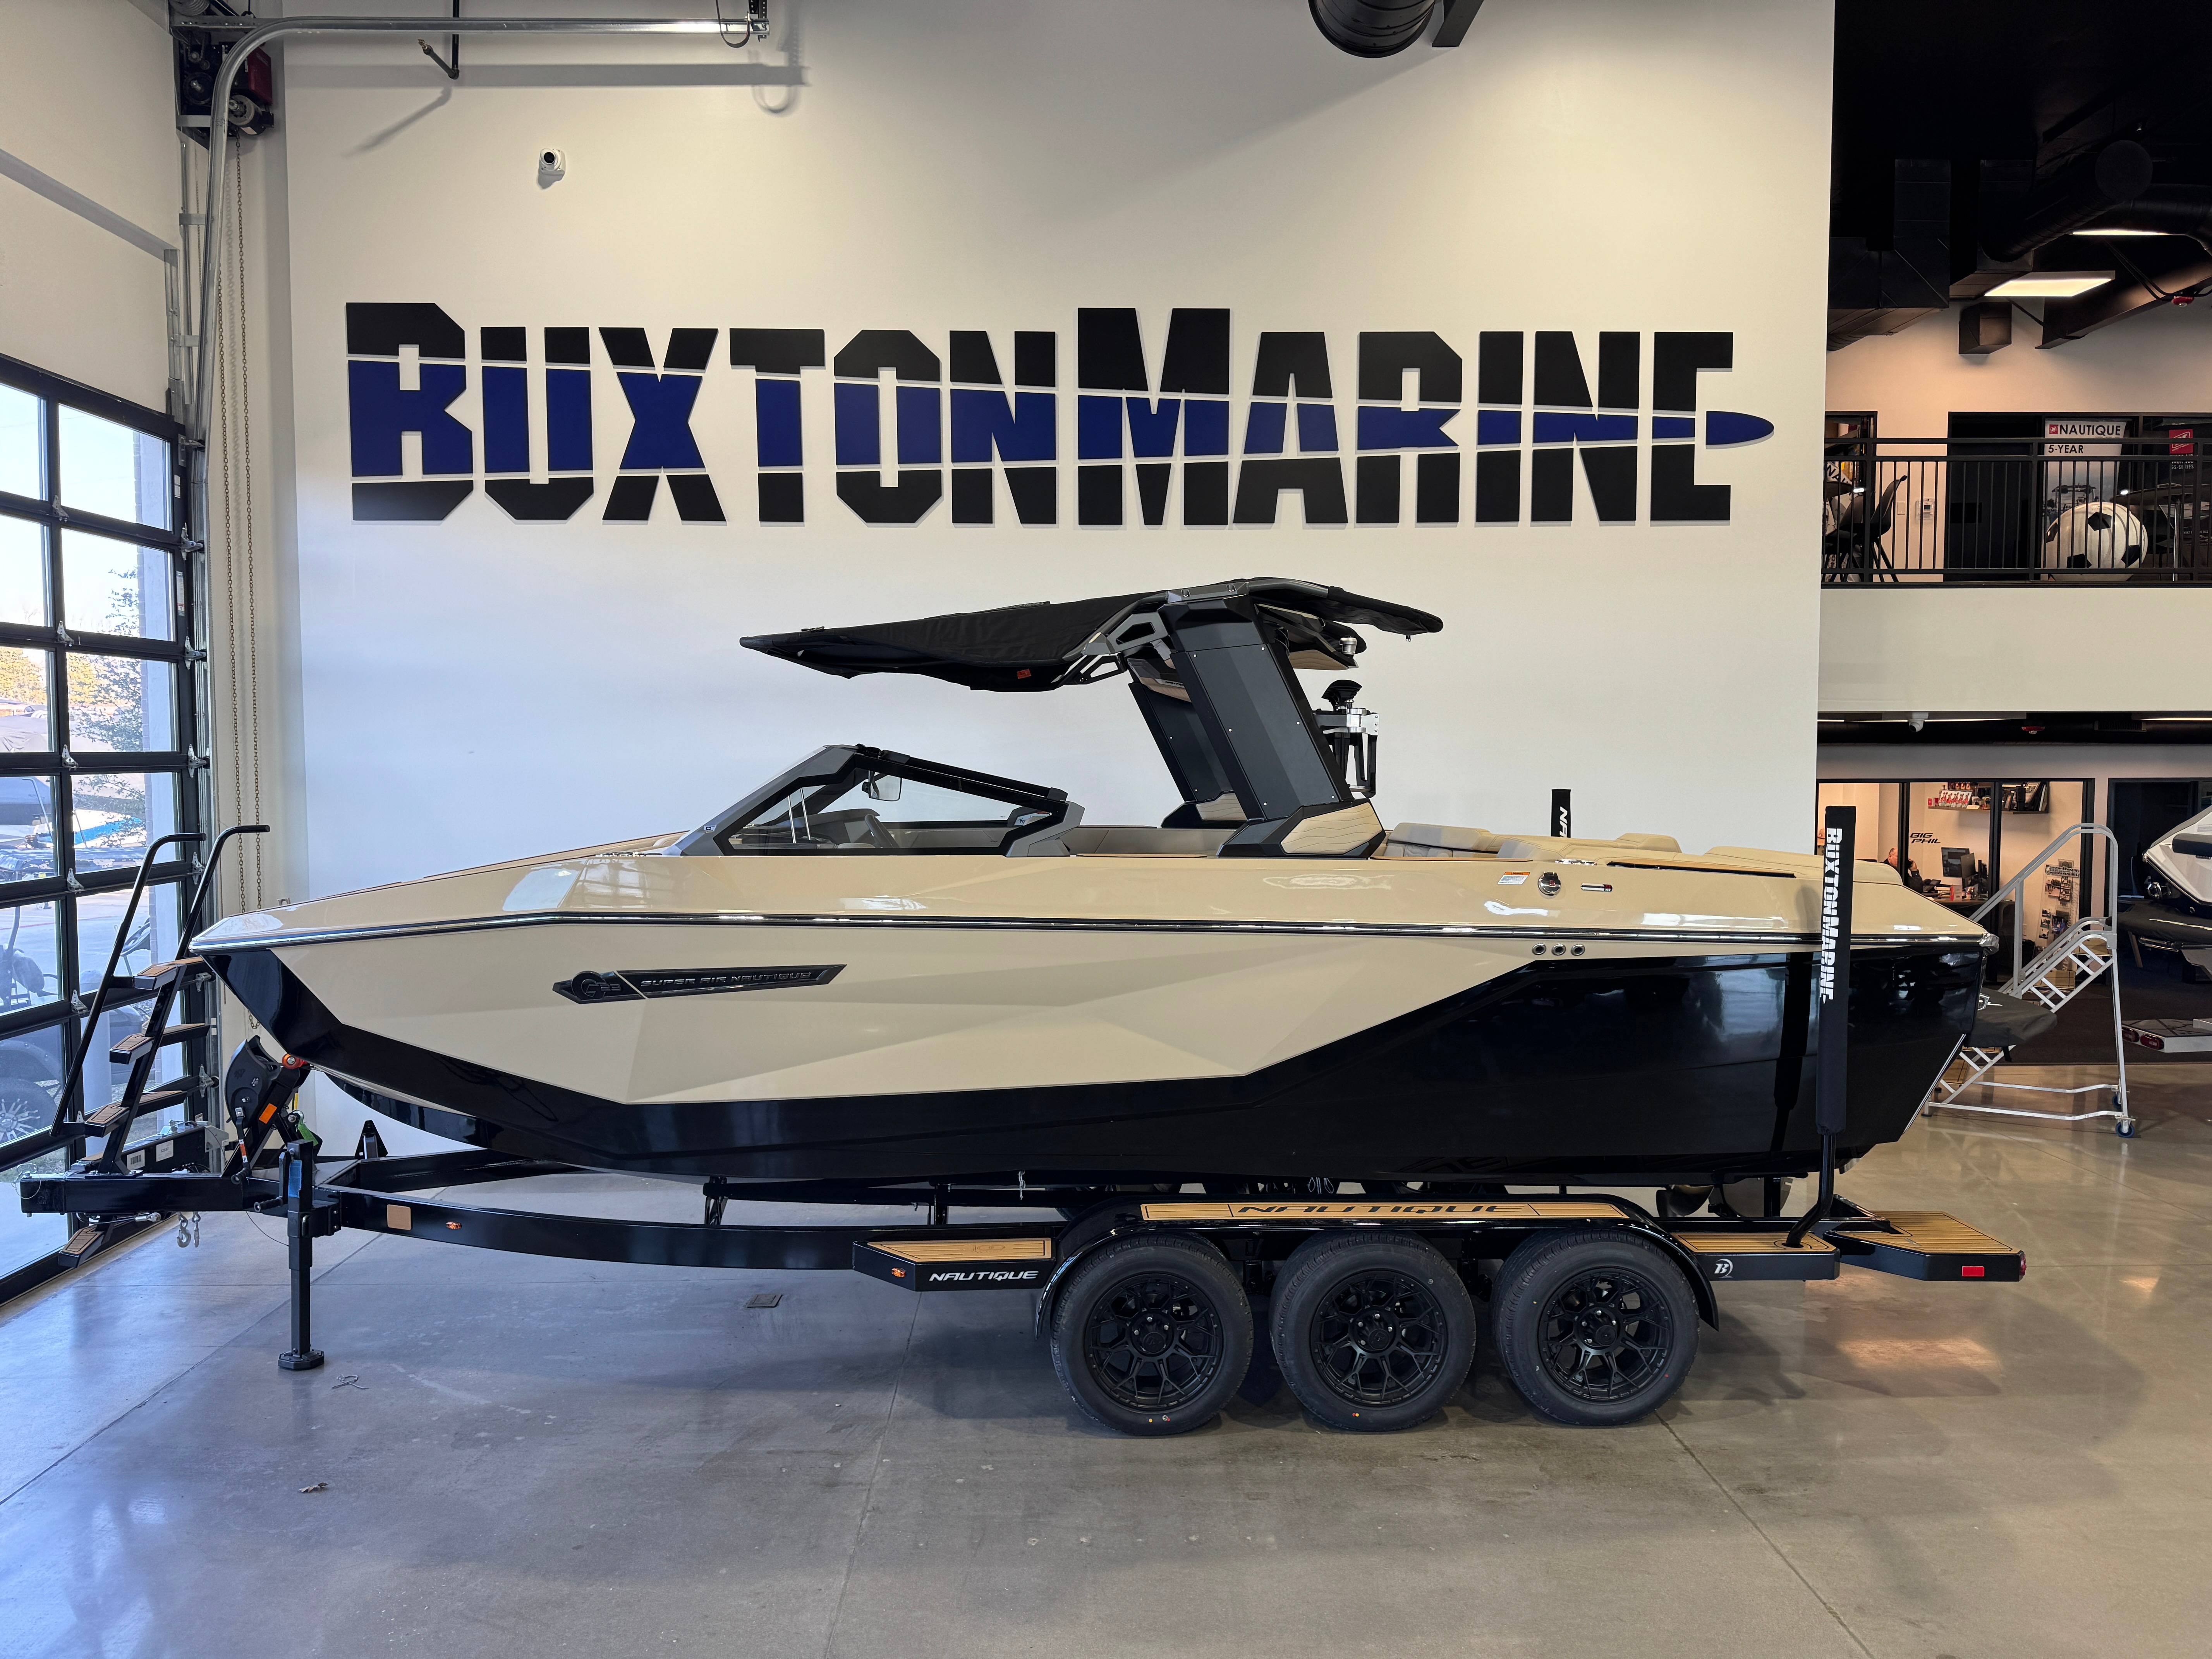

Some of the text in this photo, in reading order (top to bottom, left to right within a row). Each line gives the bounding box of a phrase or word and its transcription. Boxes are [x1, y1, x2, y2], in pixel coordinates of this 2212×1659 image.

[2059, 424, 2121, 436] NAUTIQUE
[2048, 445, 2083, 453] 5-YEAR
[641, 978, 696, 986] SUPER
[731, 972, 811, 982] NAUTIQUE
[1237, 1206, 1525, 1214] NAUTIQUE
[929, 1271, 1039, 1281] NAUTIQUE
